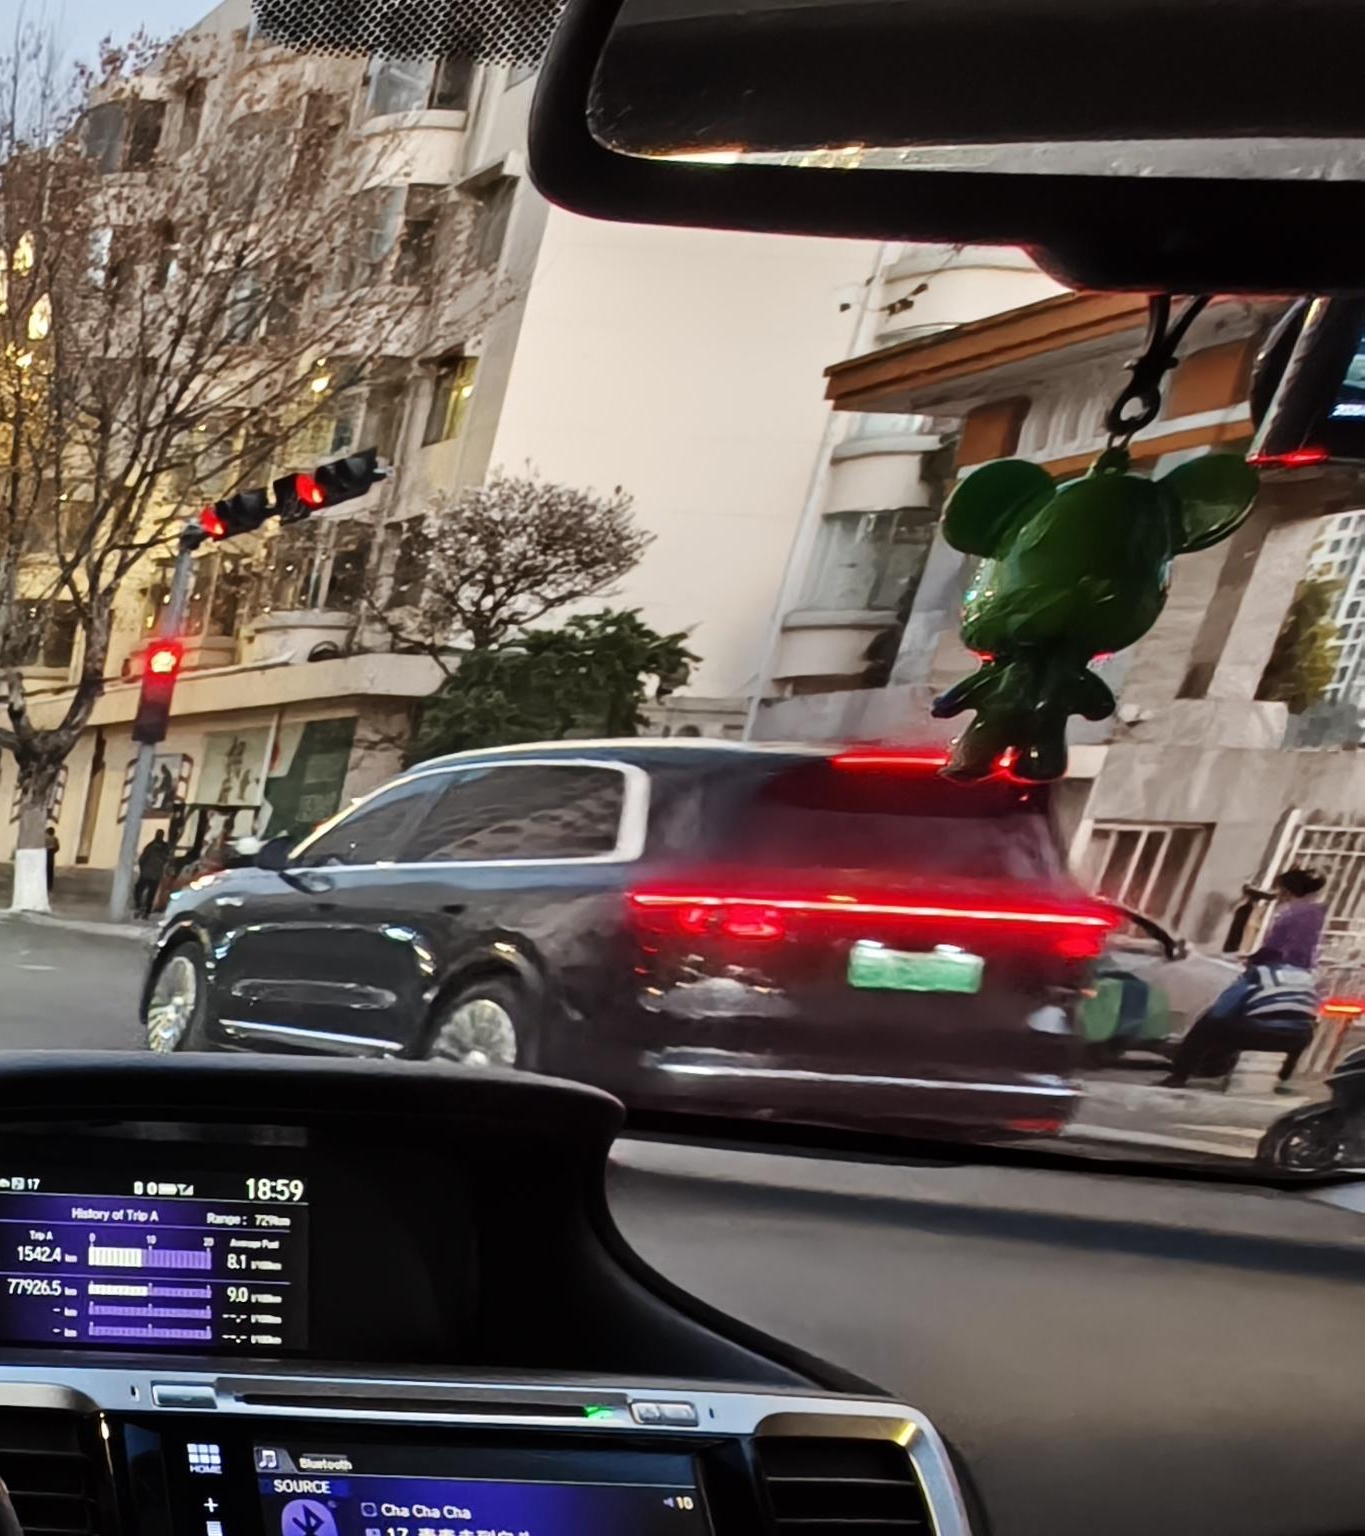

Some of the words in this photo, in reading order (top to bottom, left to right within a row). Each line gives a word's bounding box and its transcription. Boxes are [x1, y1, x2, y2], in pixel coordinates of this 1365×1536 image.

[27, 1178, 40, 1190] 17
[246, 1178, 304, 1201] 18:59
[72, 1208, 109, 1221] History
[112, 1209, 123, 1220] of
[126, 1210, 148, 1222] Trip
[150, 1211, 159, 1222] A
[146, 1235, 157, 1245] 10
[17, 1246, 62, 1262] 1542.4
[227, 1254, 246, 1269] 8.1
[7, 1279, 62, 1295] 77926.5
[227, 1287, 248, 1302] 9.0
[299, 1457, 353, 1471] Bluetooth
[273, 1479, 332, 1494] SOURCE
[675, 1496, 694, 1511] 10
[381, 1503, 410, 1518] Cha
[412, 1505, 441, 1520] Cha
[443, 1506, 471, 1521] Cha
